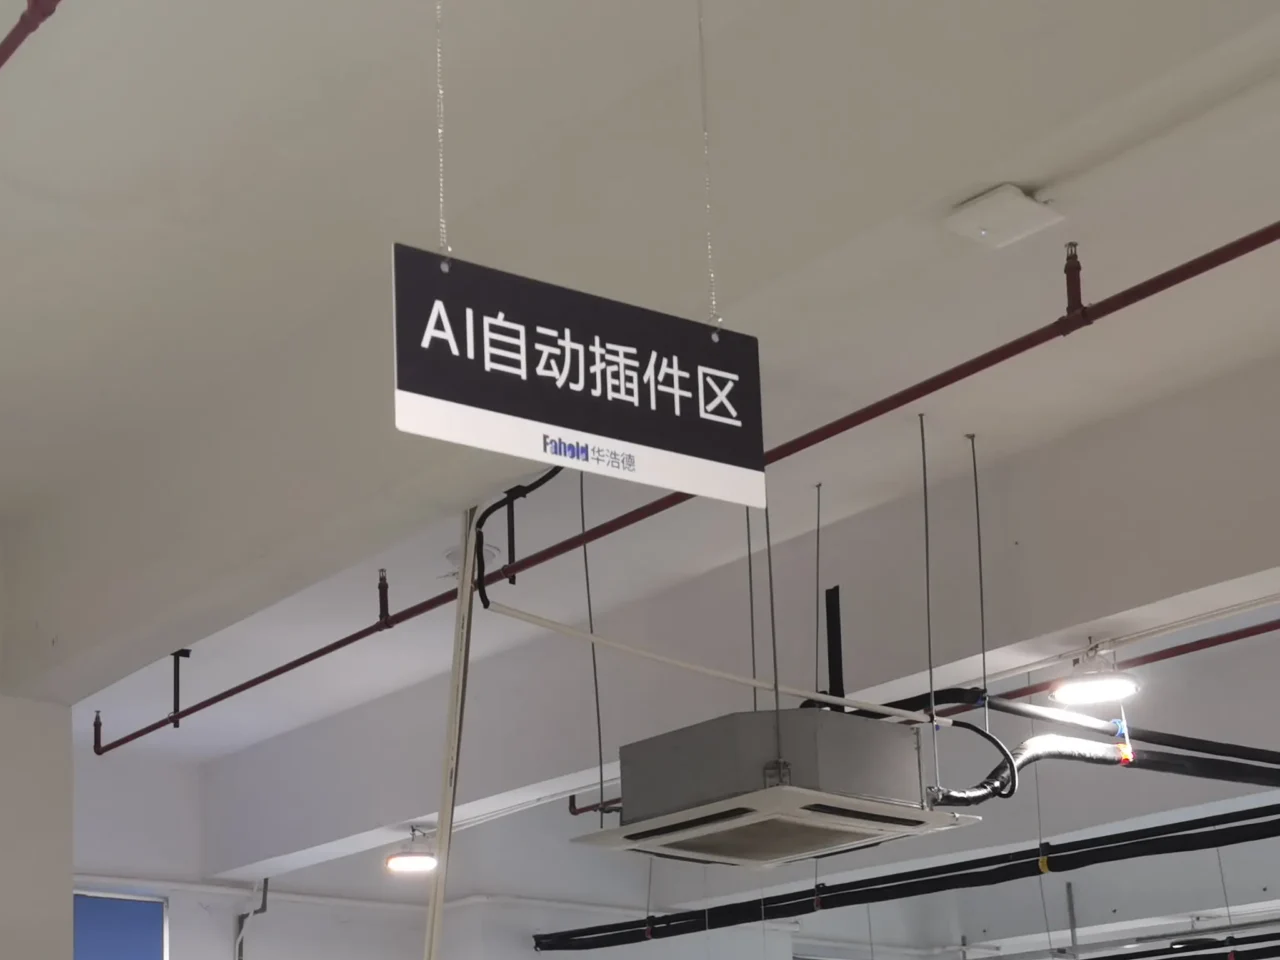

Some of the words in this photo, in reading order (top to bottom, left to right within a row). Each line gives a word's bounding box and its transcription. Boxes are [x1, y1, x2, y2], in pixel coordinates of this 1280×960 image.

[421, 300, 742, 427] AI自动插件区
[542, 433, 589, 462] Fahold
[590, 446, 636, 473] 华浩德
